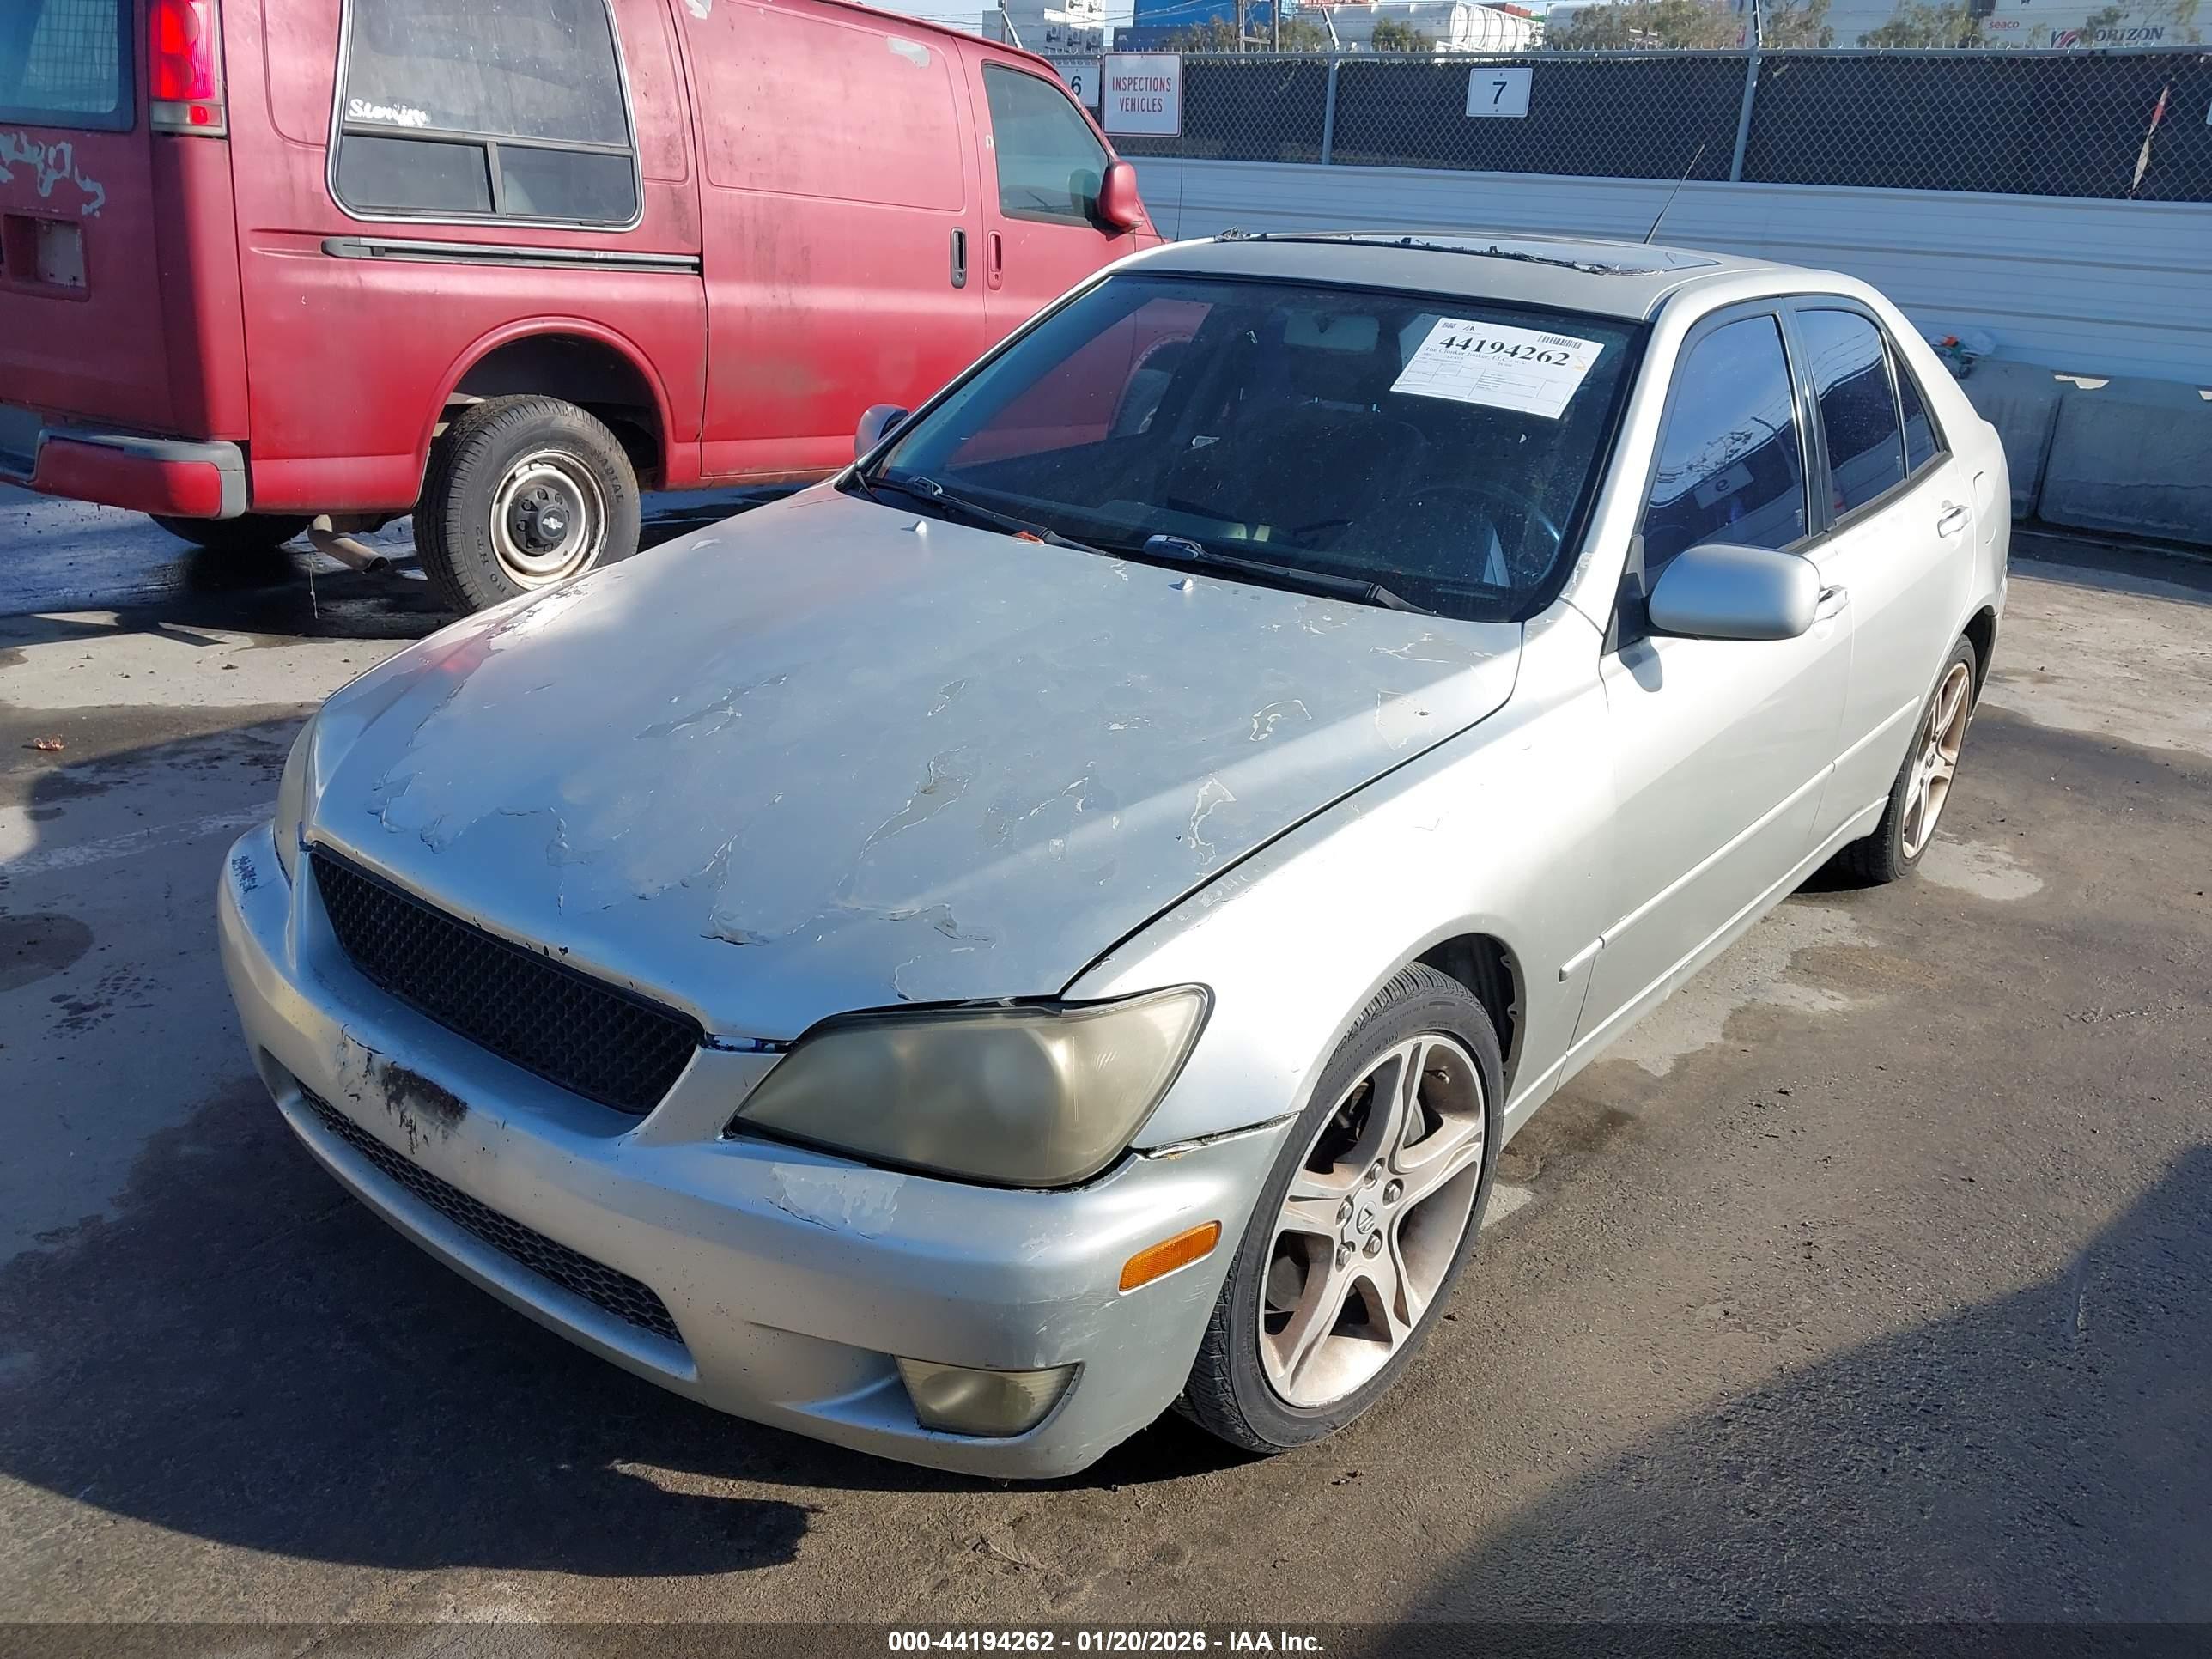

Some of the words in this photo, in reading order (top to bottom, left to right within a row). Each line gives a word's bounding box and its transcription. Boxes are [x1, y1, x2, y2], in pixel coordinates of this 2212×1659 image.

[1989, 21, 2020, 29] seaco
[1071, 76, 1082, 96] 6
[1112, 76, 1172, 92] INSPECTIONS
[1492, 81, 1508, 105] 7
[1119, 97, 1163, 112] VEHICLES
[1439, 335, 1571, 367] 44194262
